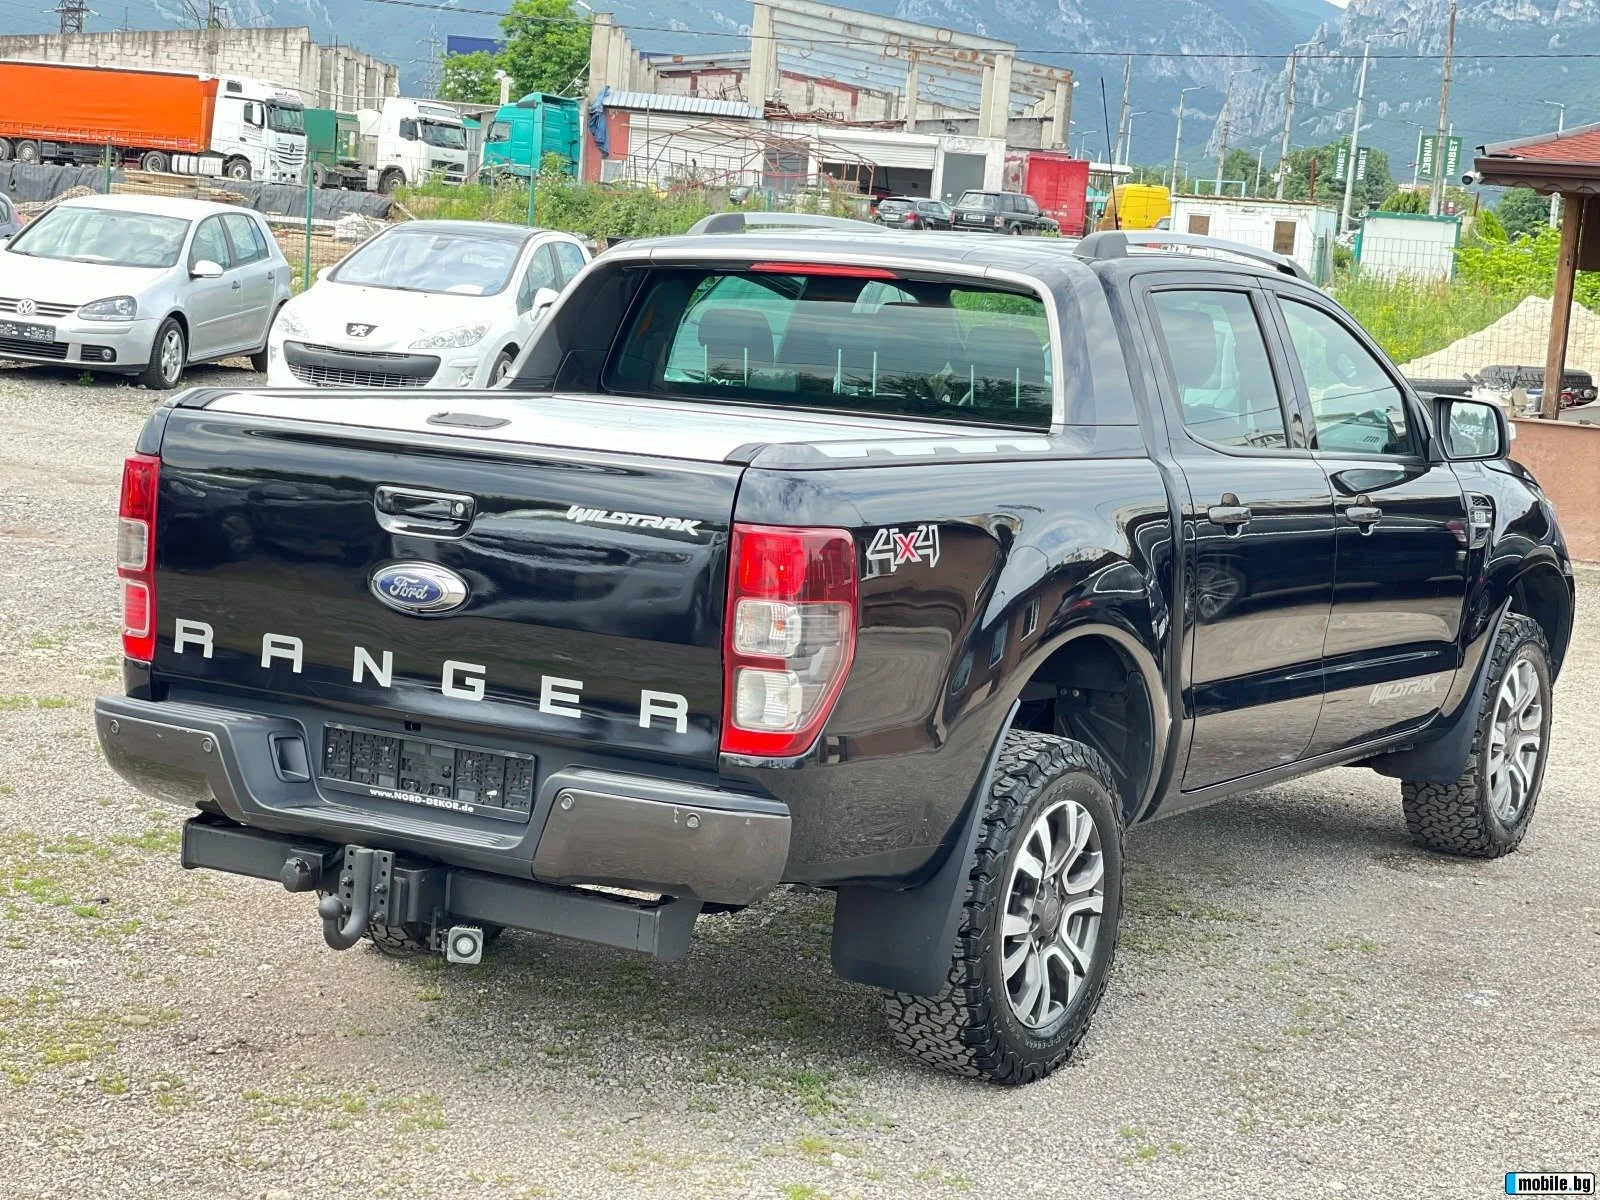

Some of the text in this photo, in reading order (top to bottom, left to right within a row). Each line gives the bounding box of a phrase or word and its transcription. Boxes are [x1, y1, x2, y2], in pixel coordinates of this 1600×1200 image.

[1335, 148, 1346, 179] WINBET
[1357, 149, 1368, 180] WINBET
[1422, 138, 1433, 175] WINBET
[1446, 139, 1458, 176] WINBET
[565, 504, 702, 536] WILDTRAK
[389, 576, 429, 600] Ford
[173, 617, 689, 734] RANGER
[1368, 675, 1440, 706] WILDTRAK
[369, 788, 474, 813] www.NORD-DEKOR.de
